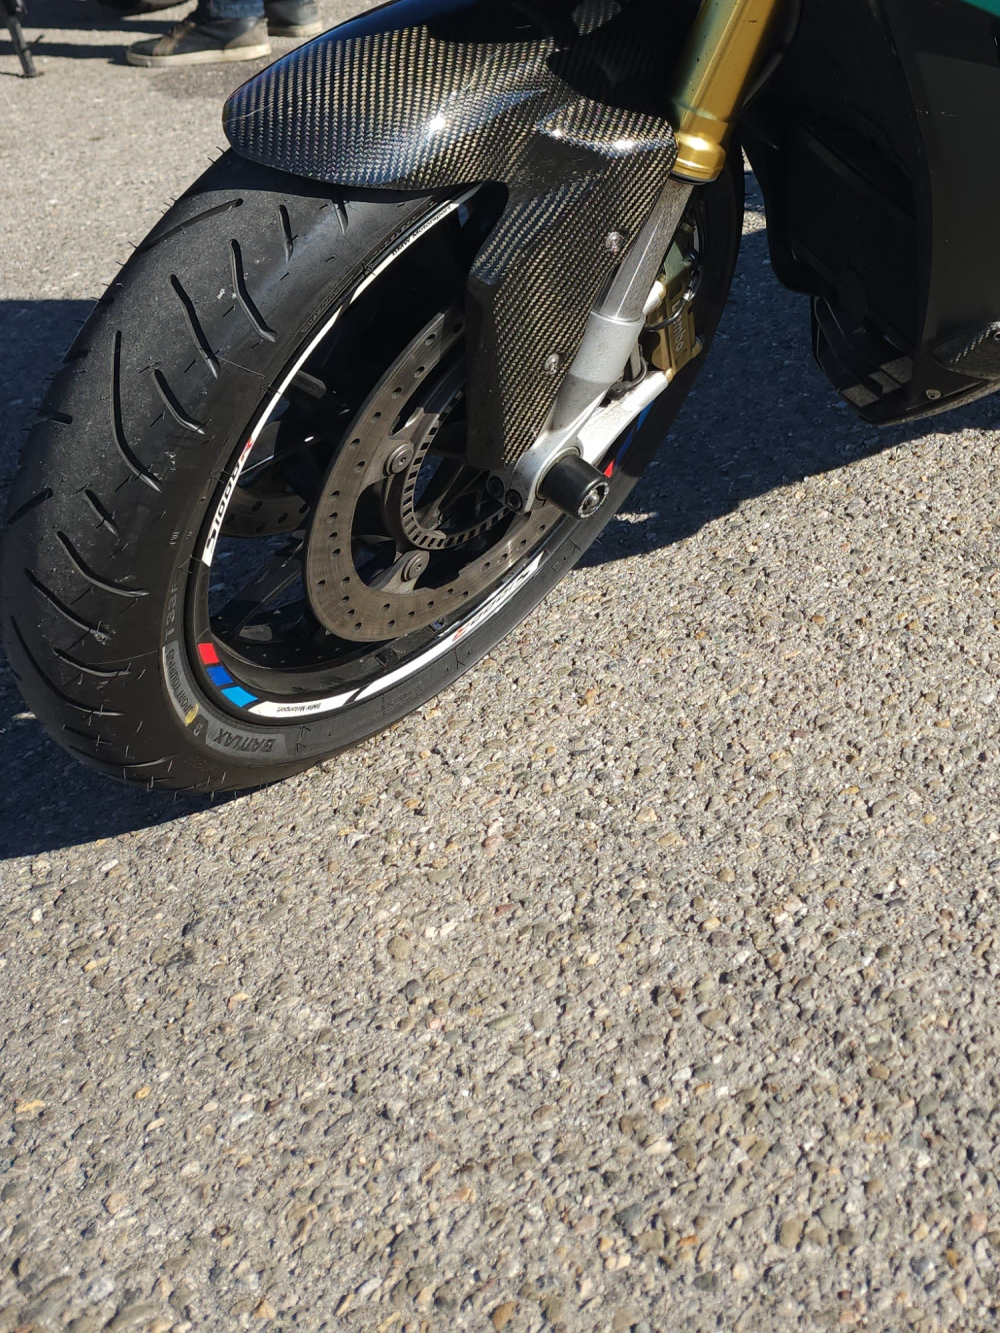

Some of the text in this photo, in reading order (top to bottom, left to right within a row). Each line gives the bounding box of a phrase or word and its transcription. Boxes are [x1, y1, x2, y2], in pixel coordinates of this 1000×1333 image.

[671, 300, 687, 353] Bembo
[205, 436, 255, 550] S1000R
[166, 649, 182, 693] TOURING
[212, 727, 277, 754] BATTLAX
